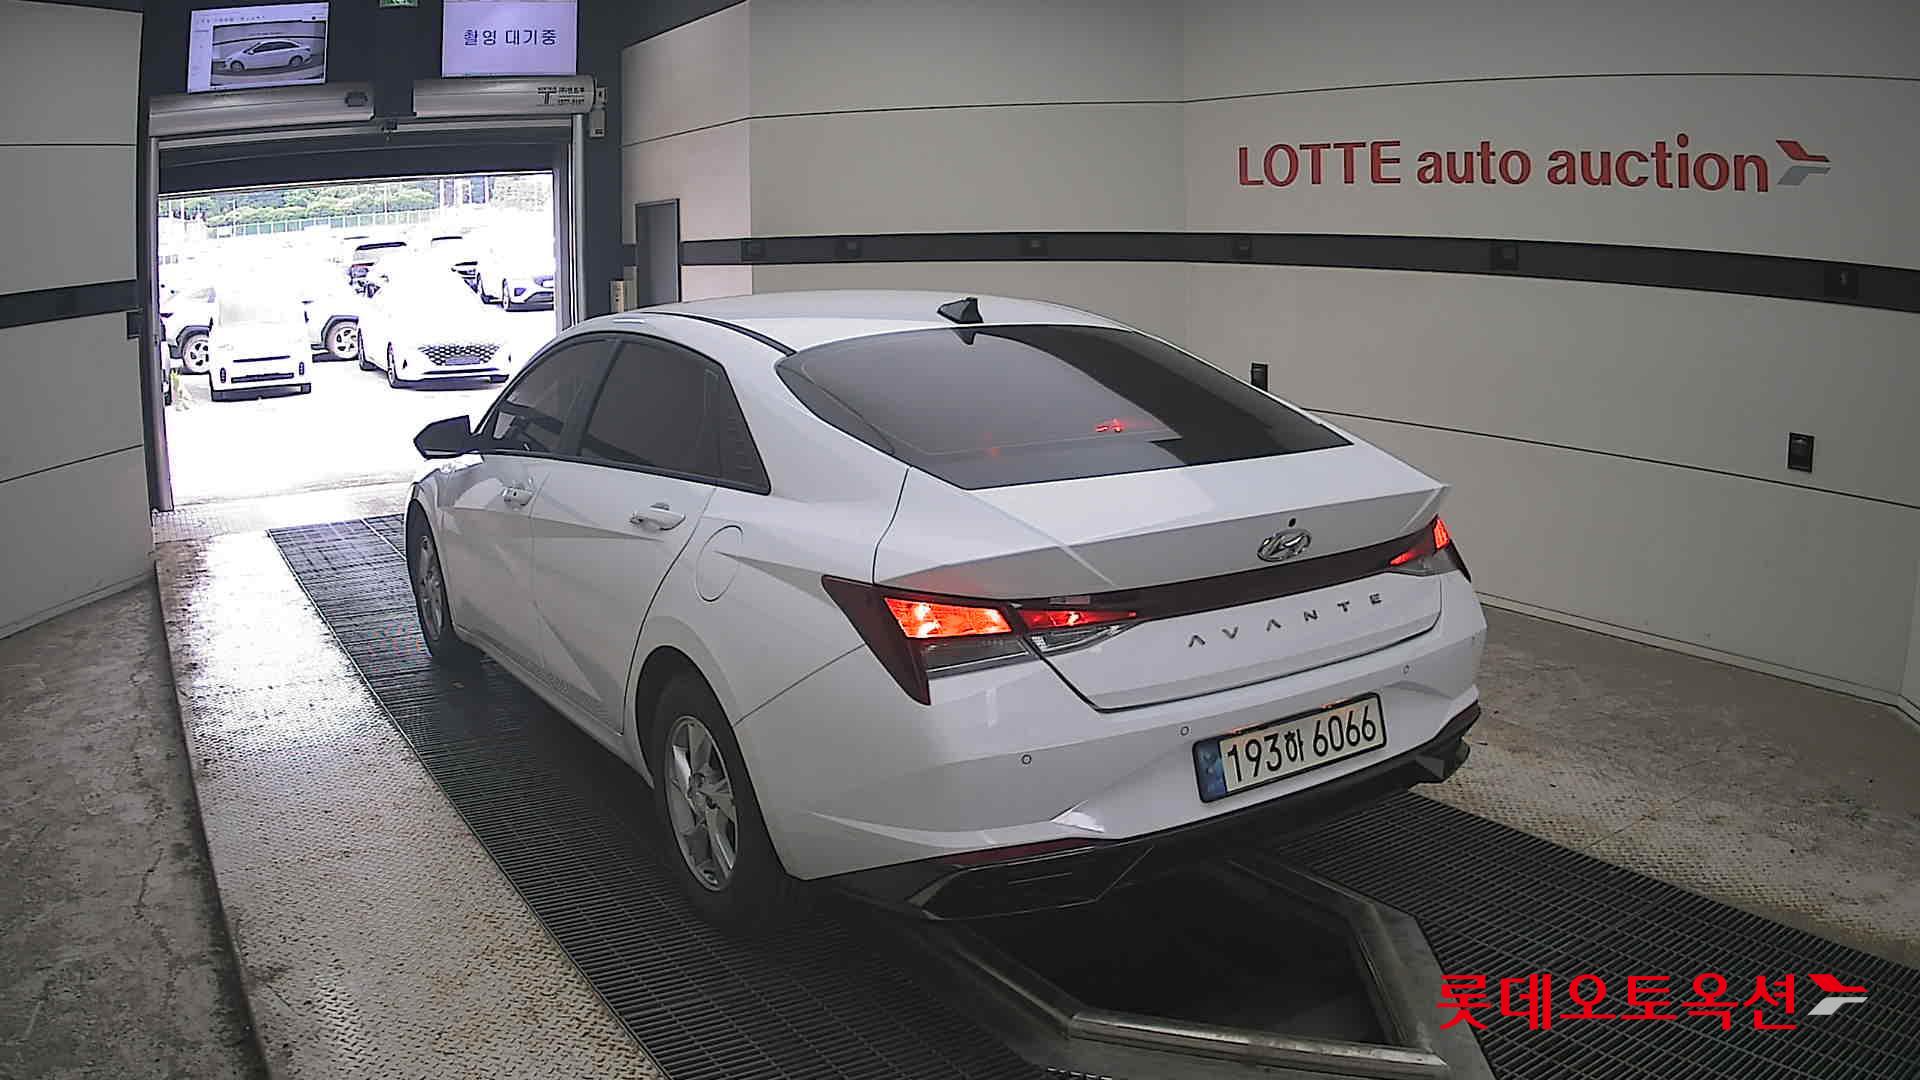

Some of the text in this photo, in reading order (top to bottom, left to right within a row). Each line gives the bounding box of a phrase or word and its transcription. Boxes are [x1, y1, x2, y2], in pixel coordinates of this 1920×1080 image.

[505, 28, 557, 46] 대기중
[1238, 132, 1769, 193] LOTTE auto auction
[1187, 592, 1383, 648] AVANTE
[1226, 704, 1377, 783] 193하 6066
